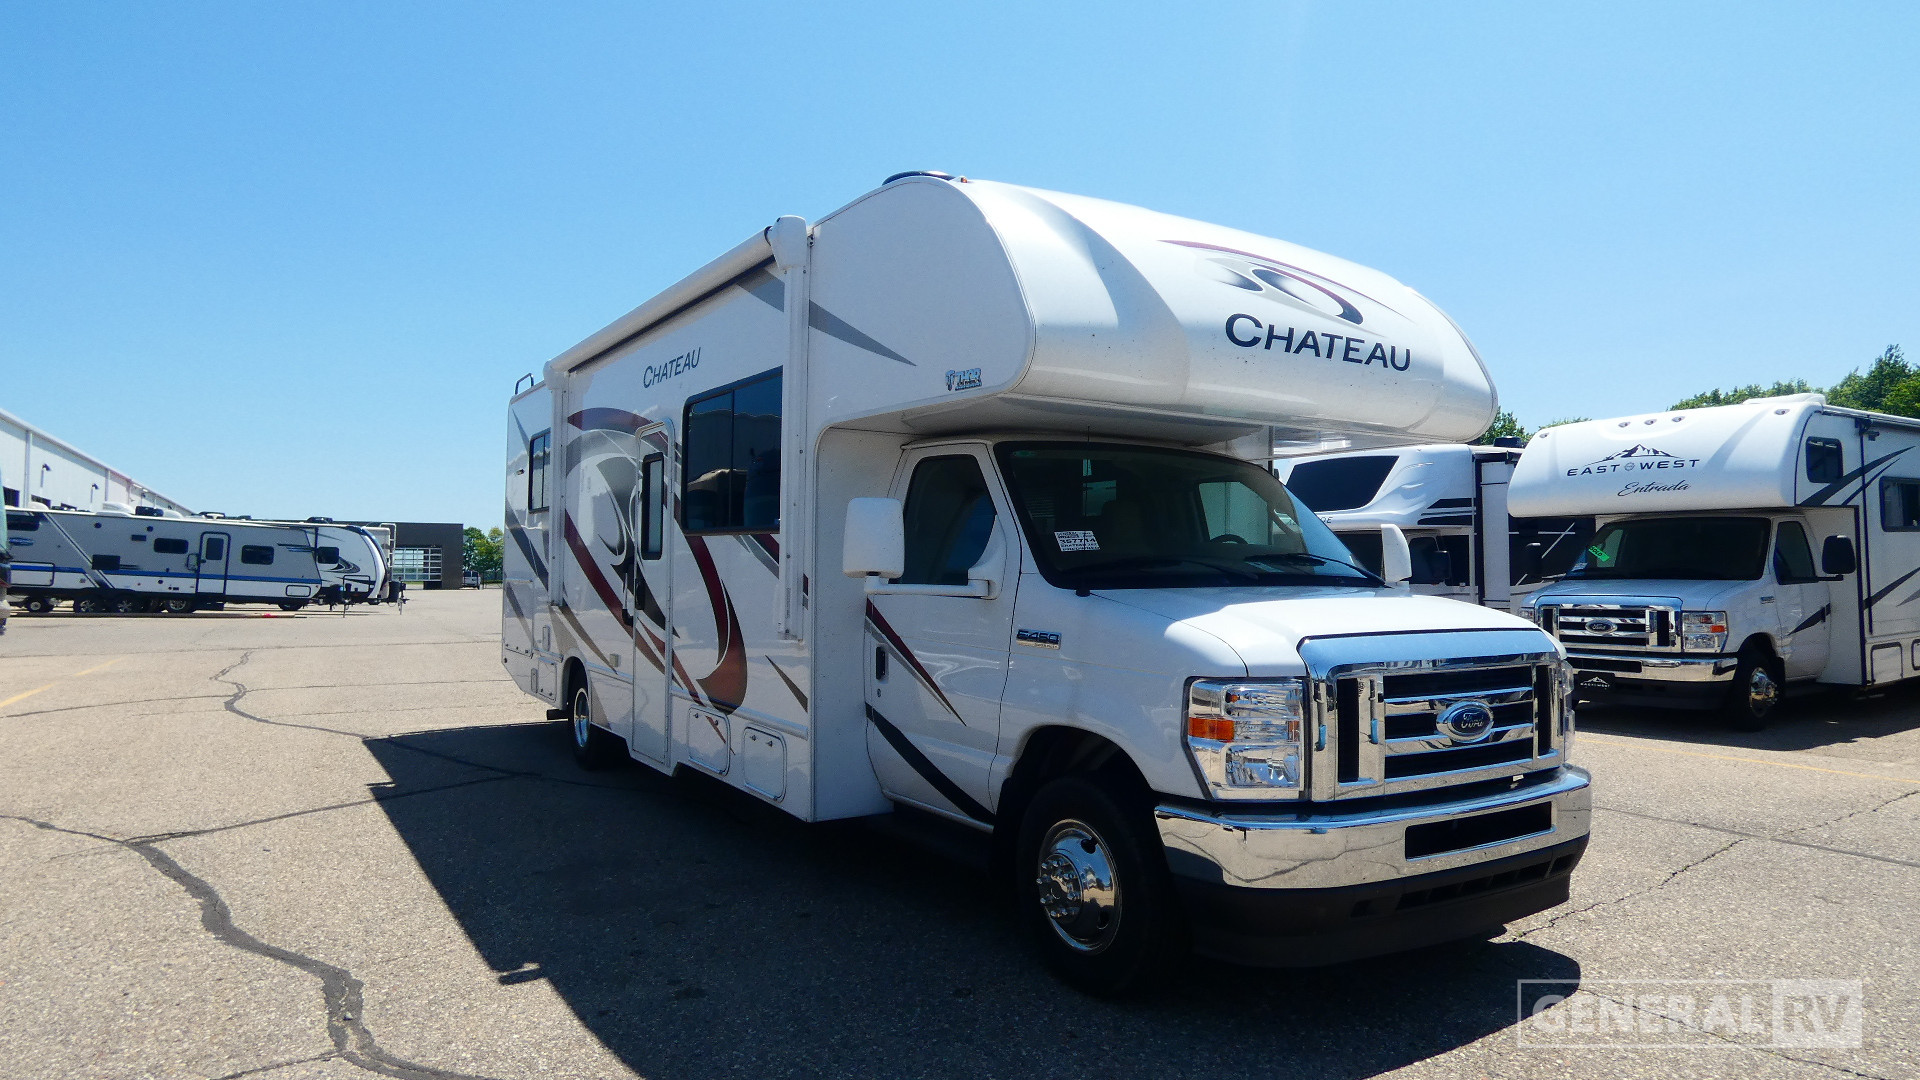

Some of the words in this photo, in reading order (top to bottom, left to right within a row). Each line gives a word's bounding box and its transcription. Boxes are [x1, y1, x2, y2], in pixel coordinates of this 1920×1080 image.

[1225, 313, 1411, 371] CHATEAU
[643, 347, 701, 388] CHATEAU
[1567, 464, 1620, 476] EAST
[1640, 459, 1700, 470] WEST
[1617, 479, 1691, 497] Entrada
[1461, 712, 1484, 729] Ford
